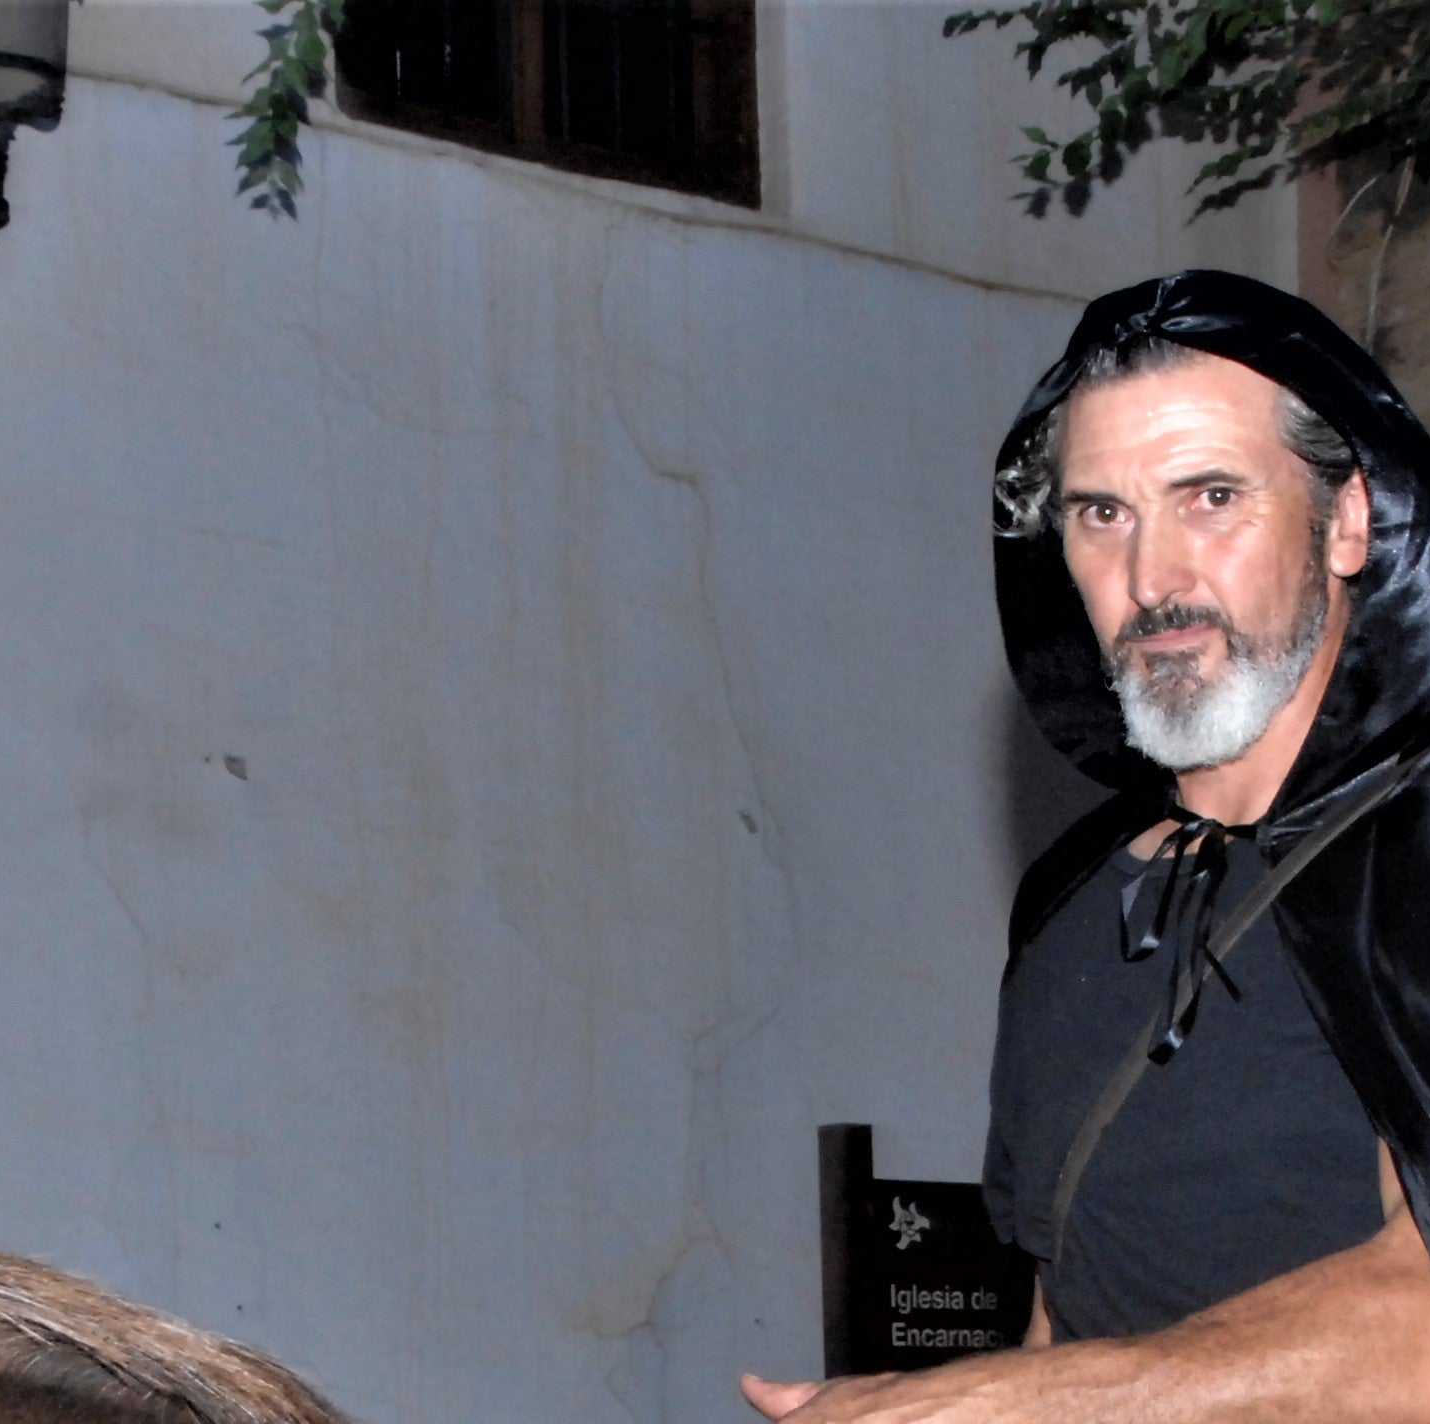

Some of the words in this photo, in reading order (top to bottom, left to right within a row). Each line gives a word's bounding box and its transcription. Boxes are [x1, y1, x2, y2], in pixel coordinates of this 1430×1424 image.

[890, 1283, 964, 1315] Iglesia
[970, 1285, 999, 1310] de
[891, 1321, 1002, 1348] Encarnac
